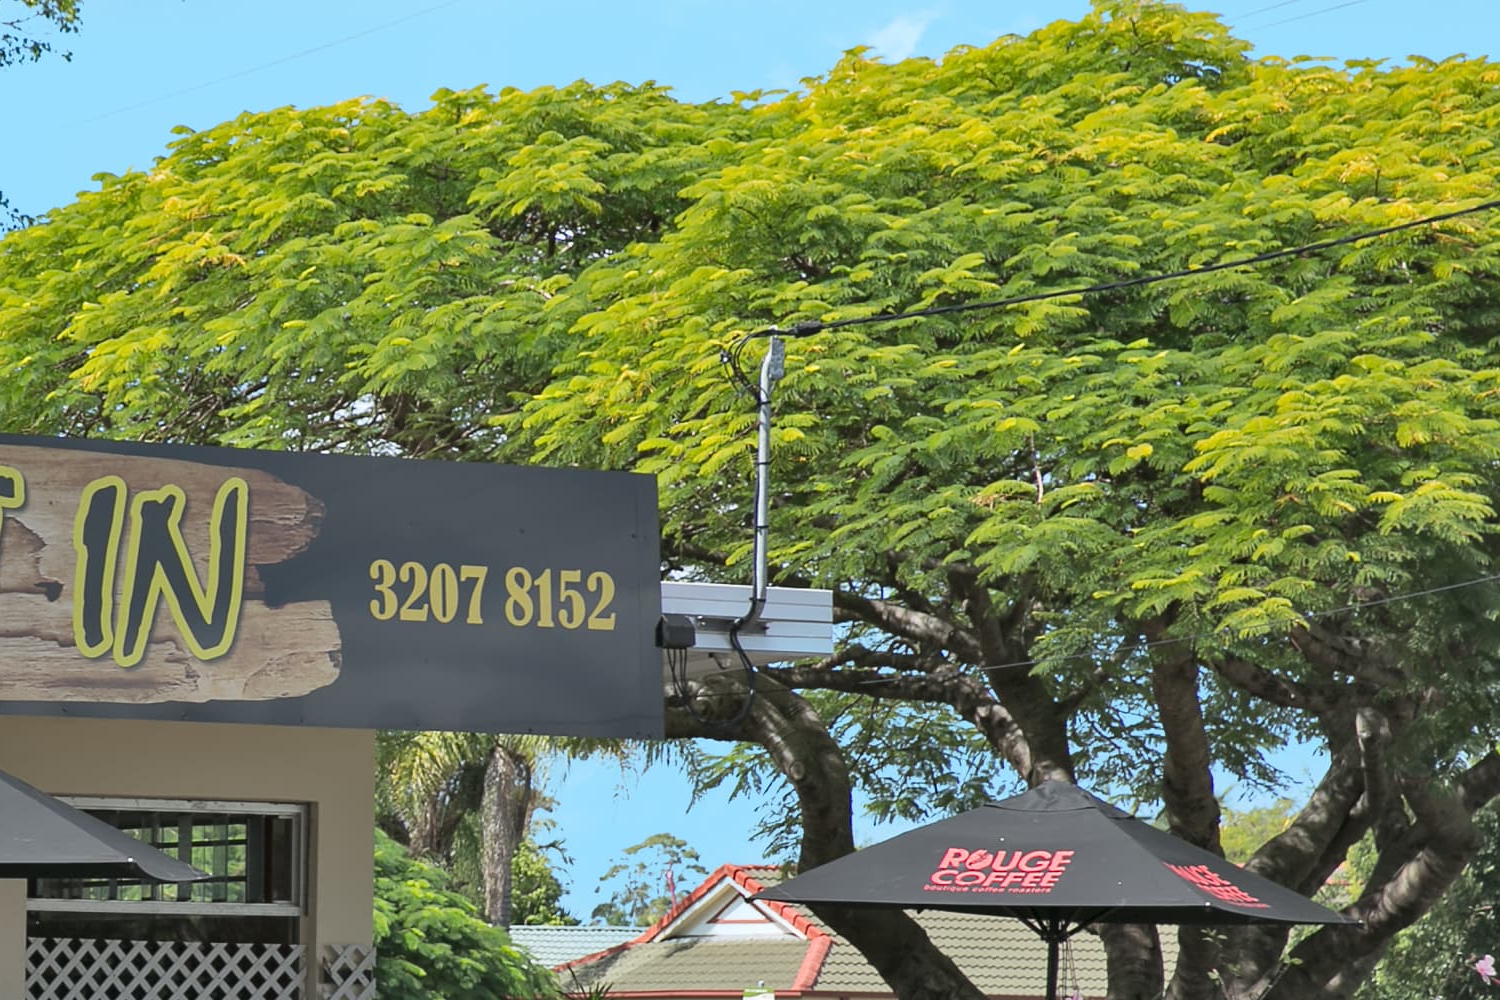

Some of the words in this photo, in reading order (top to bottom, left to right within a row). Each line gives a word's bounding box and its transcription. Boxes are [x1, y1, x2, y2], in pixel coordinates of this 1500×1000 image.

[74, 475, 248, 667] IN
[368, 559, 489, 625] 3207
[504, 566, 617, 632] 8152
[930, 869, 1063, 888] COFFEE
[939, 847, 1075, 872] ROUGE
